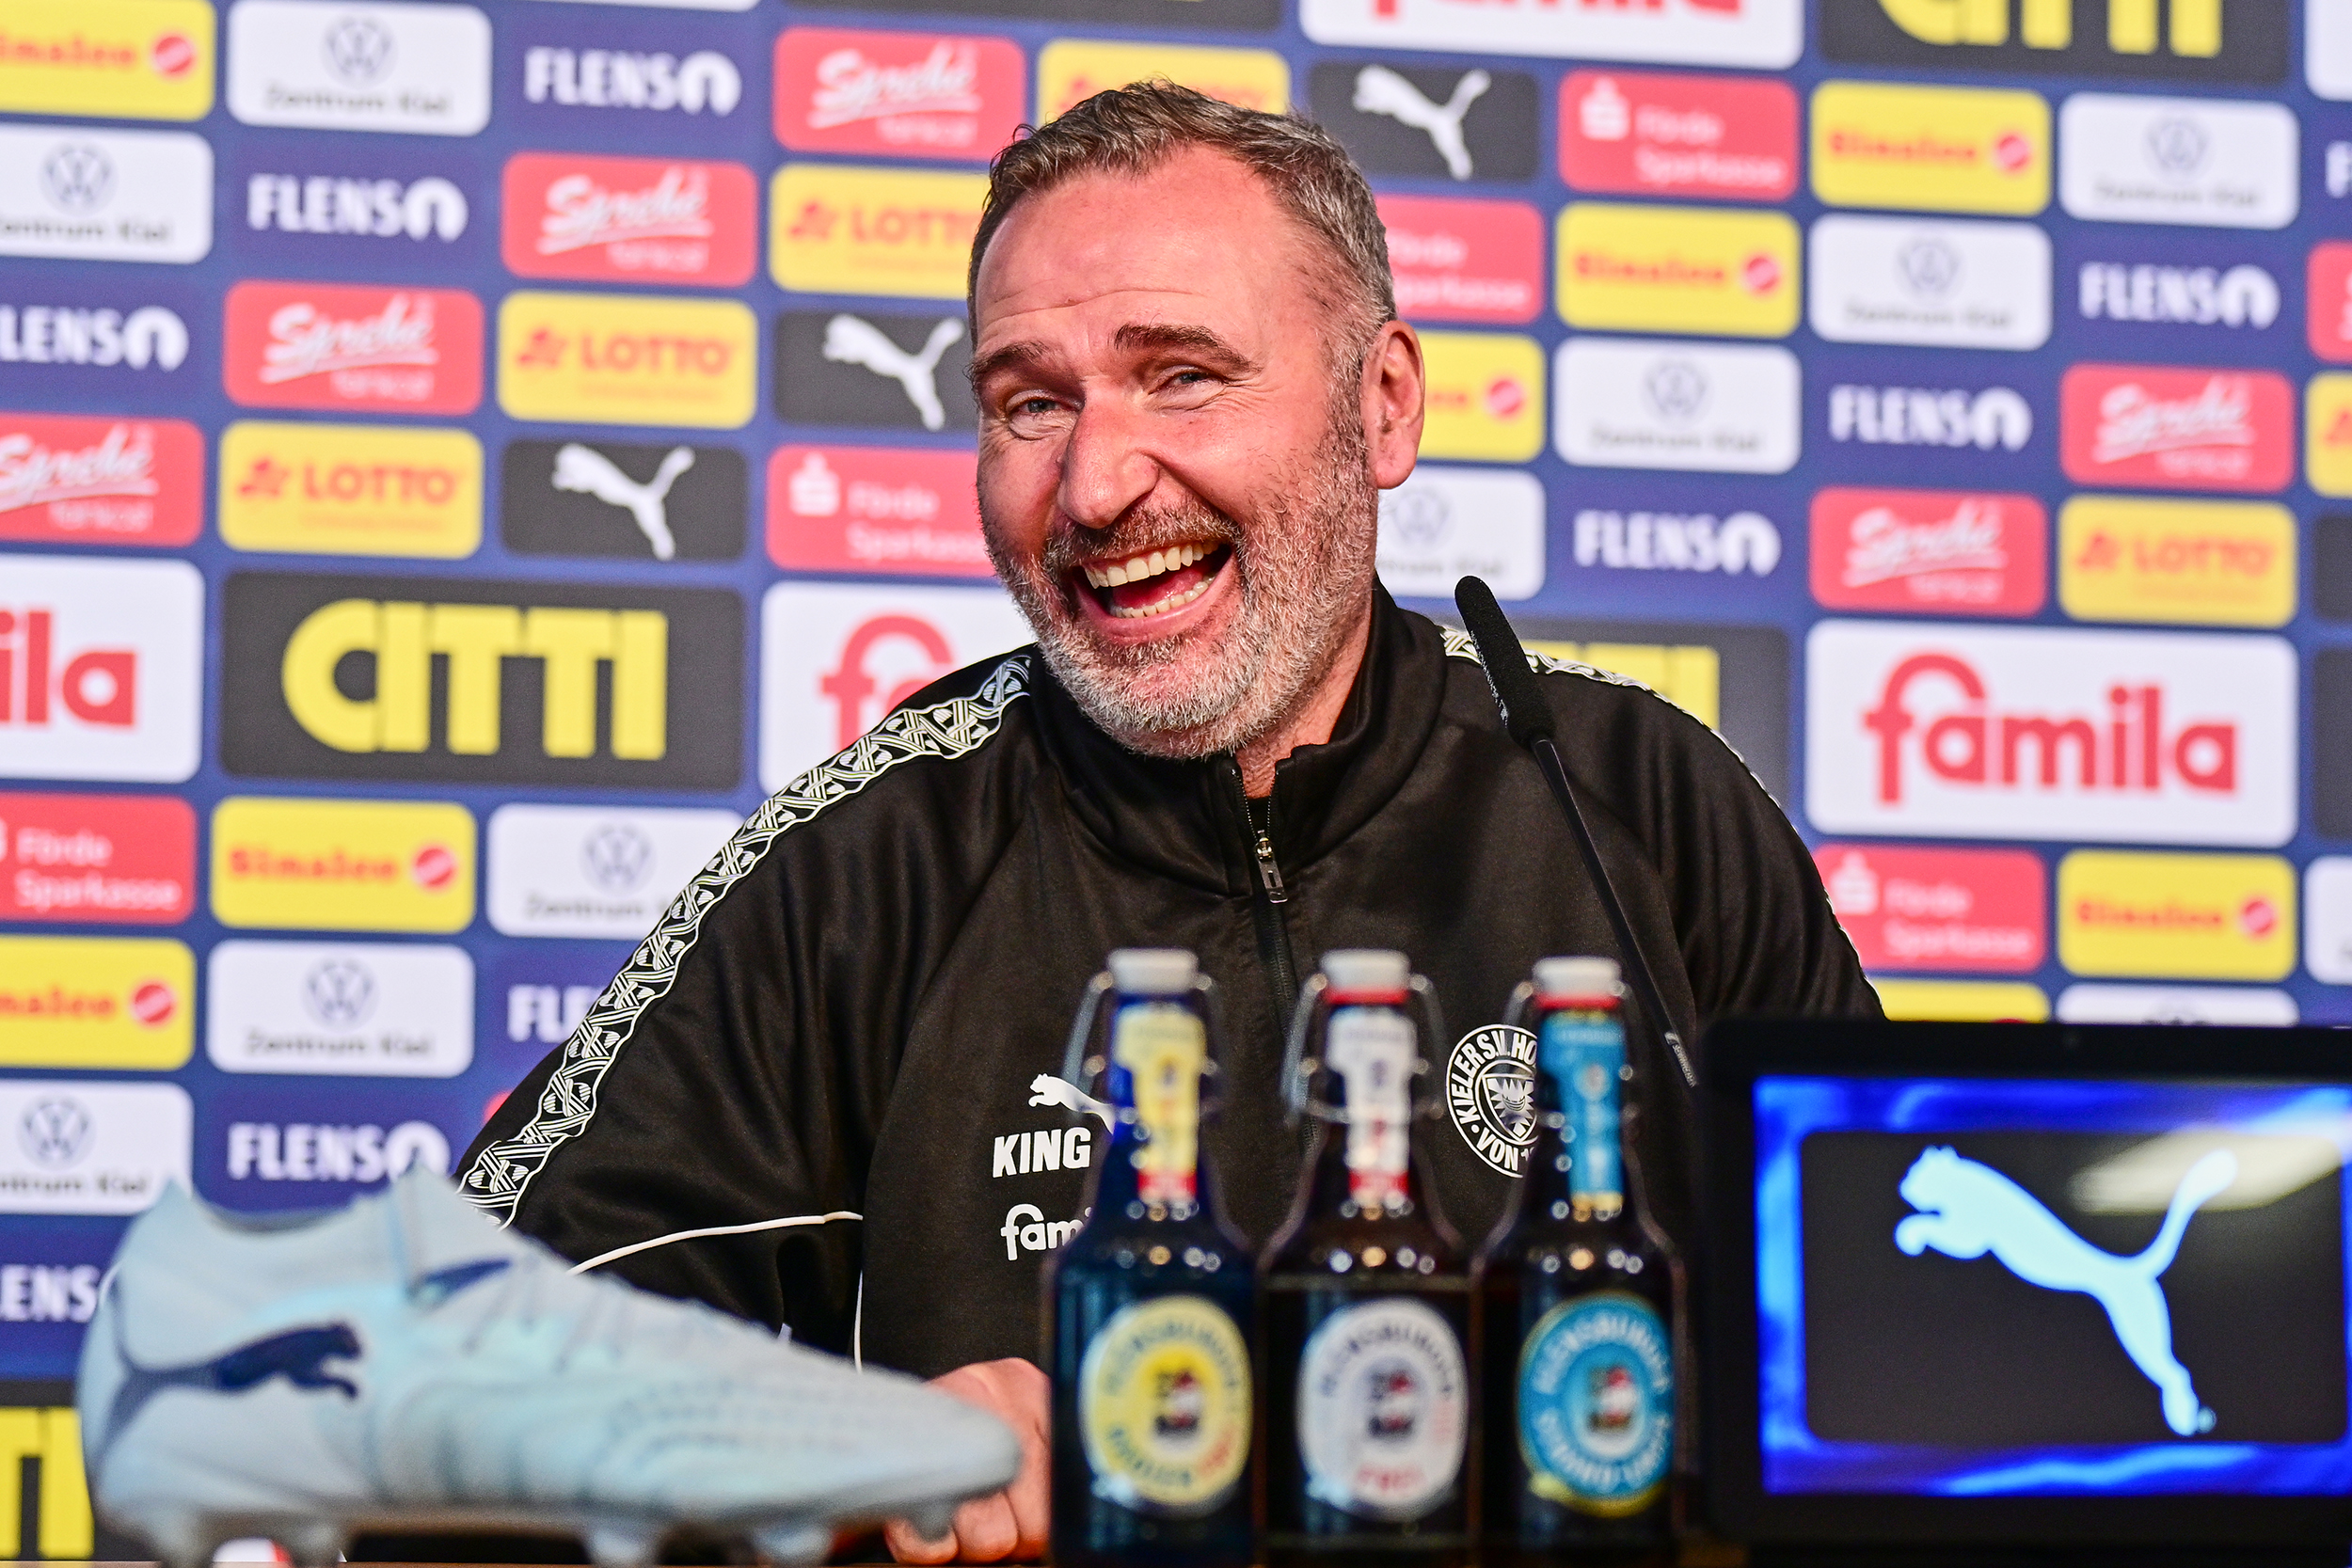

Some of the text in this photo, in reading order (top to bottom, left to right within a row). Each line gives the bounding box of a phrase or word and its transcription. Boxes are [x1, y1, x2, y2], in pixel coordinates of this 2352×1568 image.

[850, 204, 982, 248] LOTT
[0, 305, 124, 366] LENS
[577, 331, 730, 378] LOTTO
[301, 460, 458, 508] LOTTO
[0, 607, 137, 731] ila
[282, 598, 669, 761] CITTI
[1860, 652, 2239, 807] famila
[992, 1126, 1092, 1179] KING
[1476, 1127, 1518, 1172] VON
[1000, 1203, 1092, 1261] fam
